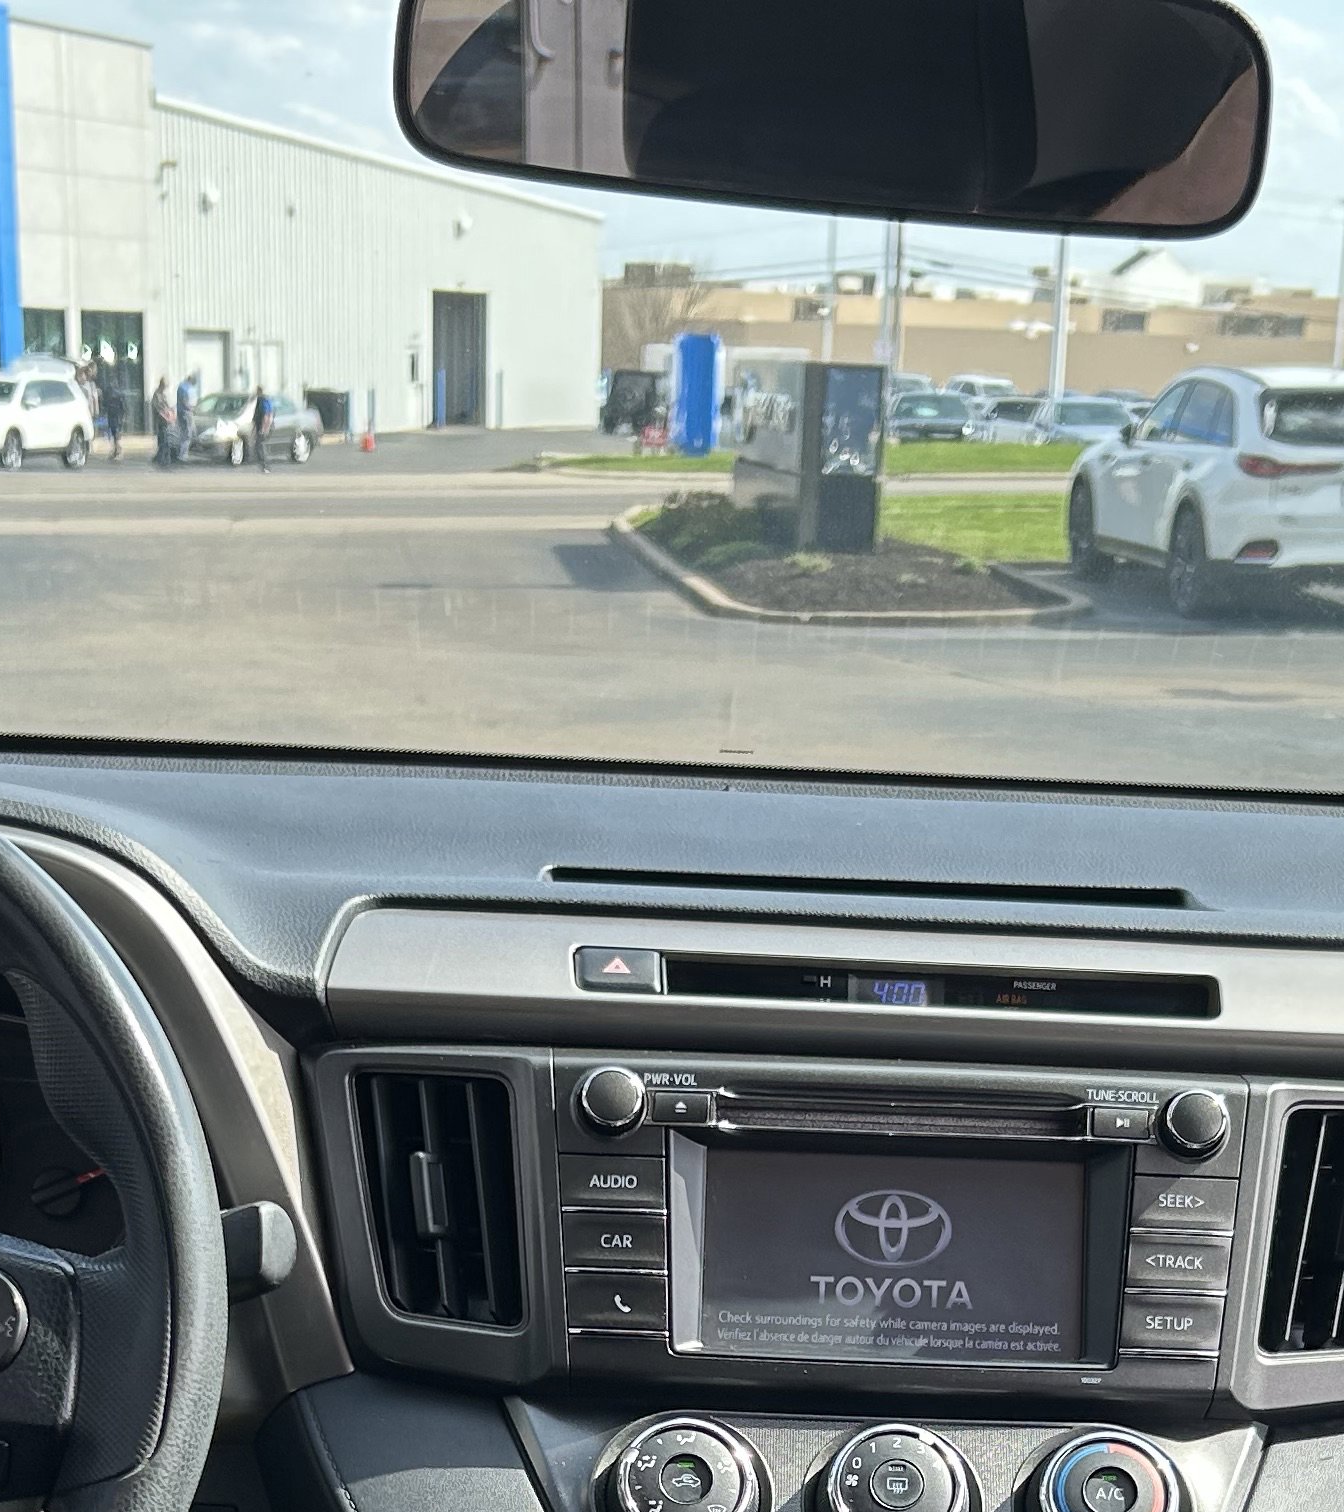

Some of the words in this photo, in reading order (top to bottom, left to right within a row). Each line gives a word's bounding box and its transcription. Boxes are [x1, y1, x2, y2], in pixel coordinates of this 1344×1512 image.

[873, 980, 926, 1006] 4:00
[1013, 980, 1057, 991] PASSENGER
[589, 1174, 638, 1189] AUDIO
[600, 1234, 633, 1249] CAR
[810, 1275, 974, 1310] TOYOTA
[718, 1310, 753, 1324] Check
[755, 1313, 823, 1329] surroundings
[825, 1313, 840, 1327] for
[843, 1315, 876, 1330] safety
[879, 1317, 906, 1330] while
[908, 1320, 947, 1331] camera
[949, 1320, 988, 1335] images
[988, 1323, 1006, 1333] are
[1008, 1322, 1061, 1337] displayed.
[1145, 1315, 1193, 1331] SETUP
[797, 1330, 809, 1343] de
[810, 1331, 843, 1346] danger
[844, 1333, 874, 1345] autour
[876, 1333, 890, 1346] du
[929, 1335, 964, 1350] lorsque
[964, 1337, 974, 1349] la
[1010, 1340, 1024, 1351] est
[869, 1442, 876, 1454] 1
[892, 1437, 902, 1449] 2
[1095, 1487, 1125, 1501] A/C
